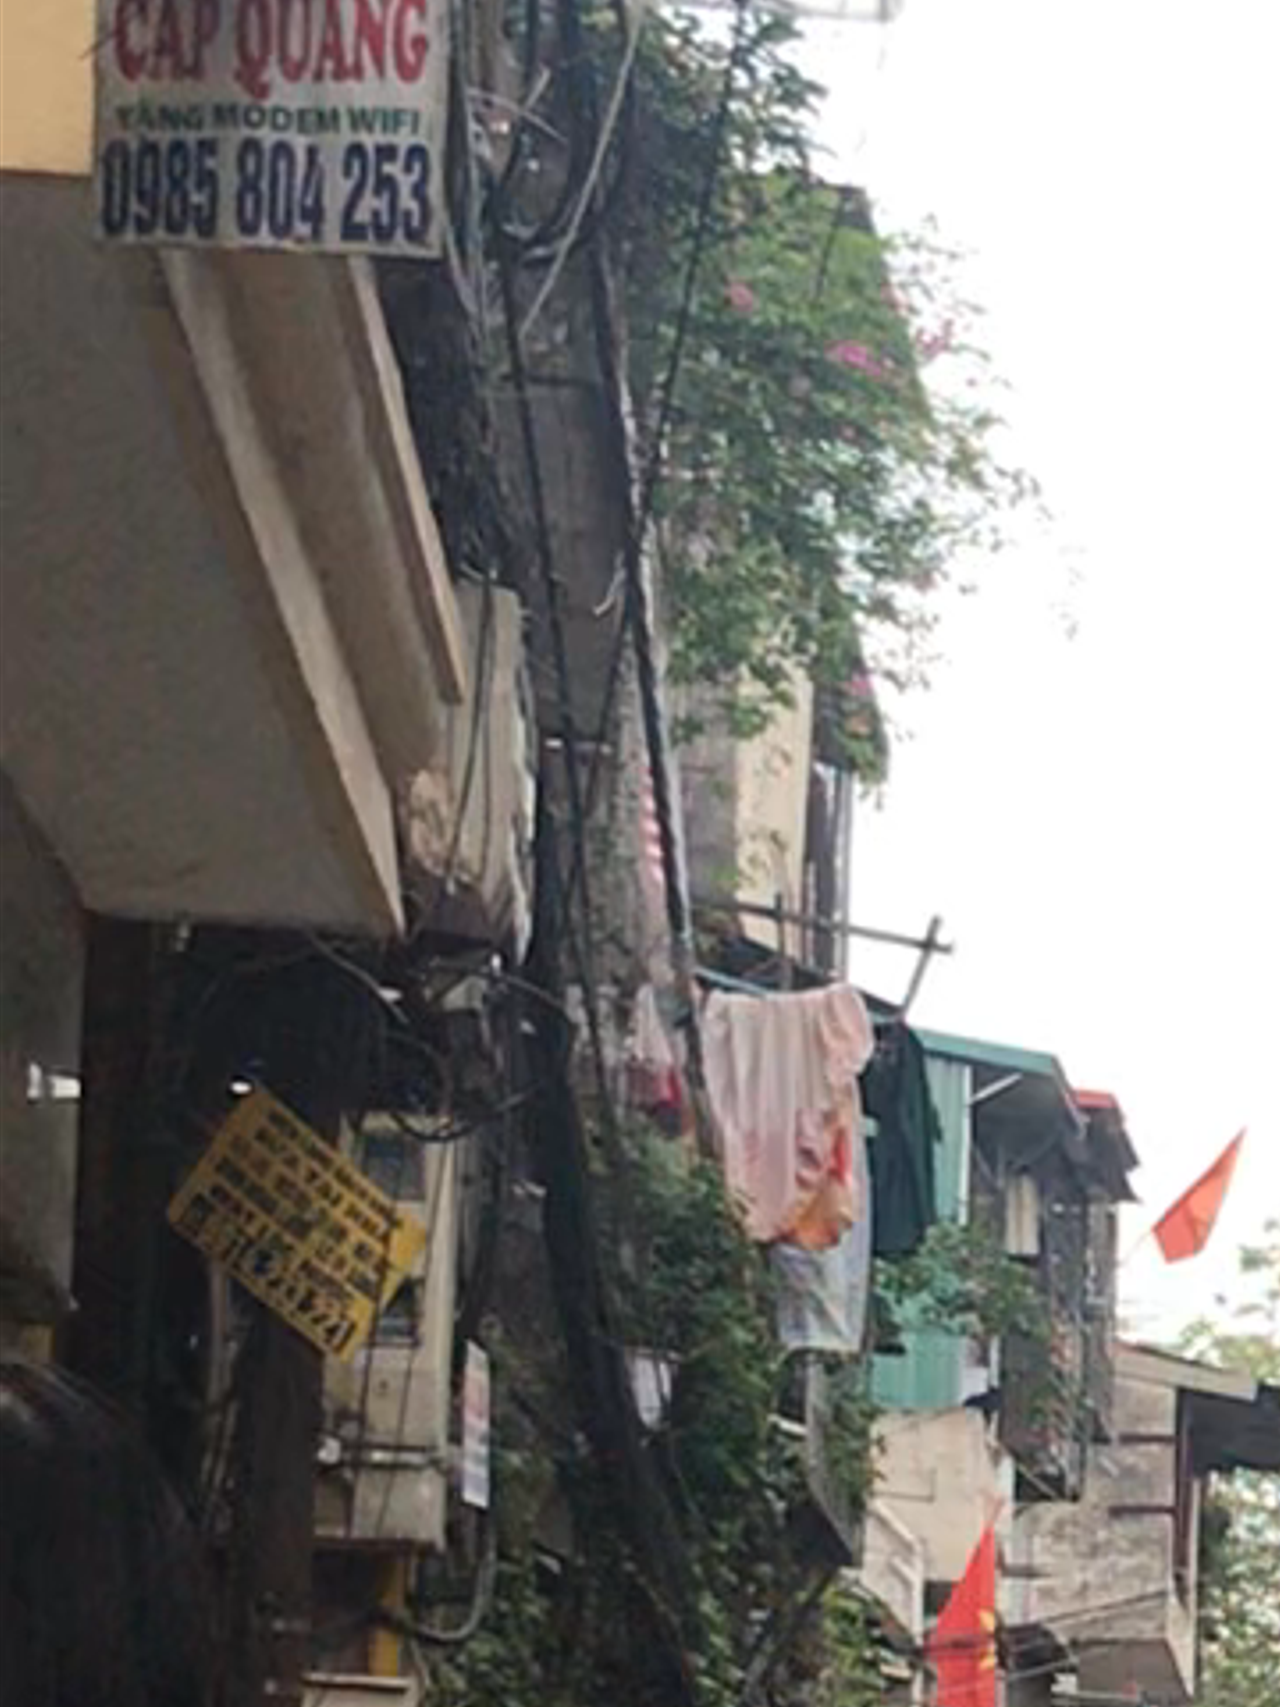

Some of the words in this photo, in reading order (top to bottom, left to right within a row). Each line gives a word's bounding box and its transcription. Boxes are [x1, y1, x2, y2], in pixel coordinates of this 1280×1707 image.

[214, 102, 341, 135] MODEM
[348, 107, 420, 135] WIFI
[102, 137, 219, 237] 0985
[236, 138, 325, 242] 804
[341, 143, 430, 244] 253
